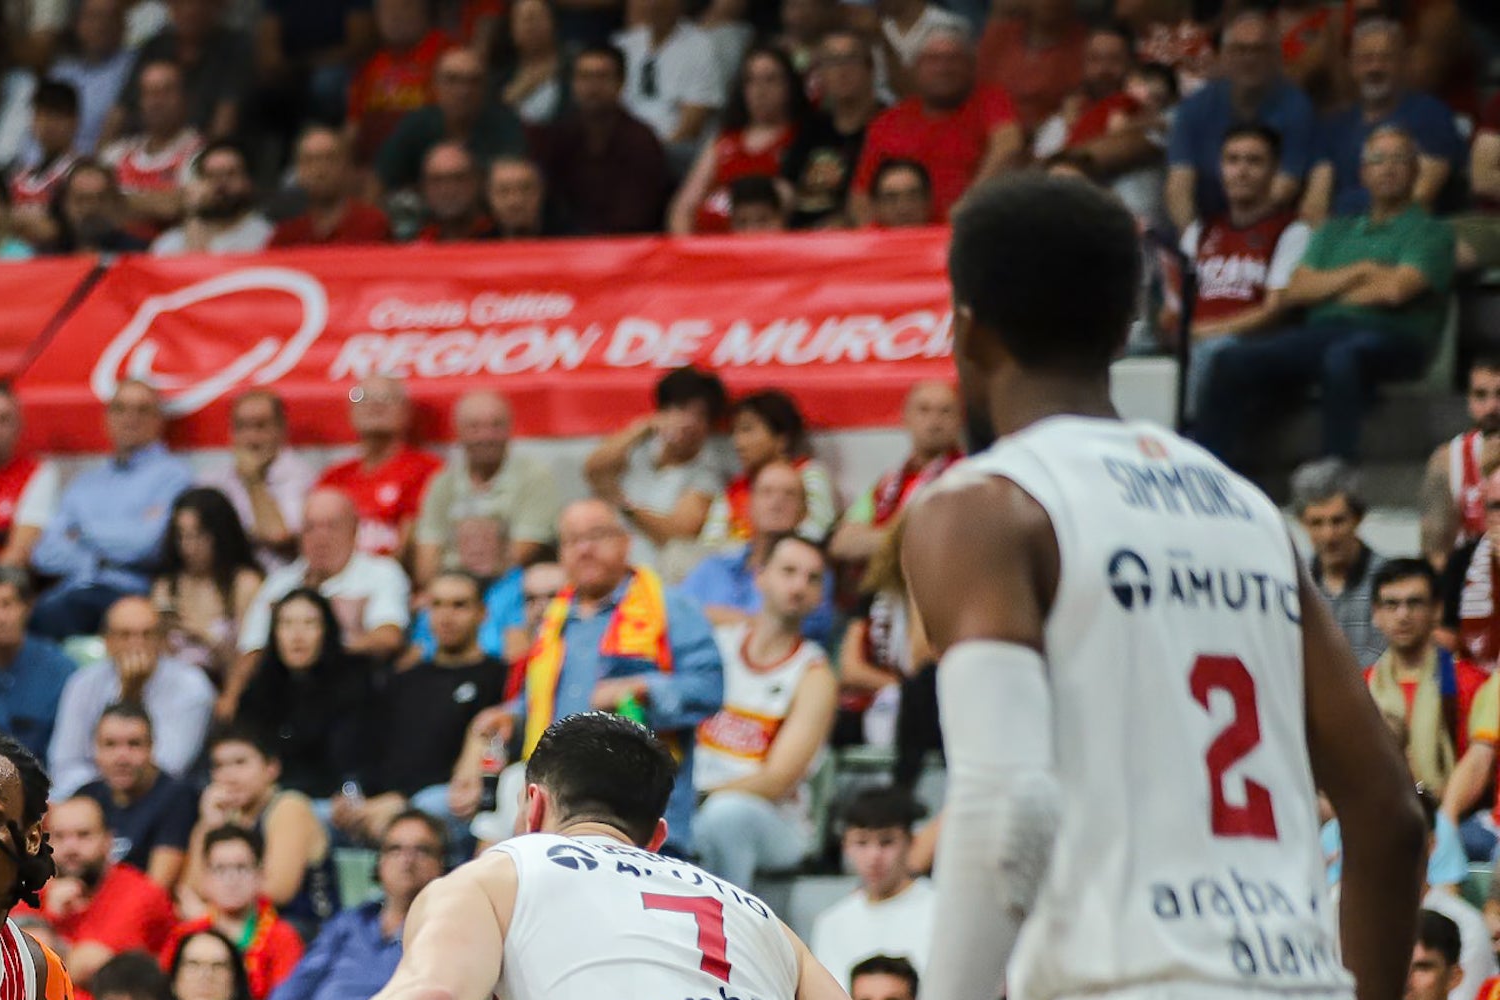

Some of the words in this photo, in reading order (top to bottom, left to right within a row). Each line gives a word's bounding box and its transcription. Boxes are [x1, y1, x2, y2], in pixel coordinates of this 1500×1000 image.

[604, 316, 709, 368] DE
[712, 310, 955, 367] MURCI
[1103, 456, 1254, 521] SIMMONS
[1188, 653, 1279, 842] 2
[640, 891, 732, 985] 7
